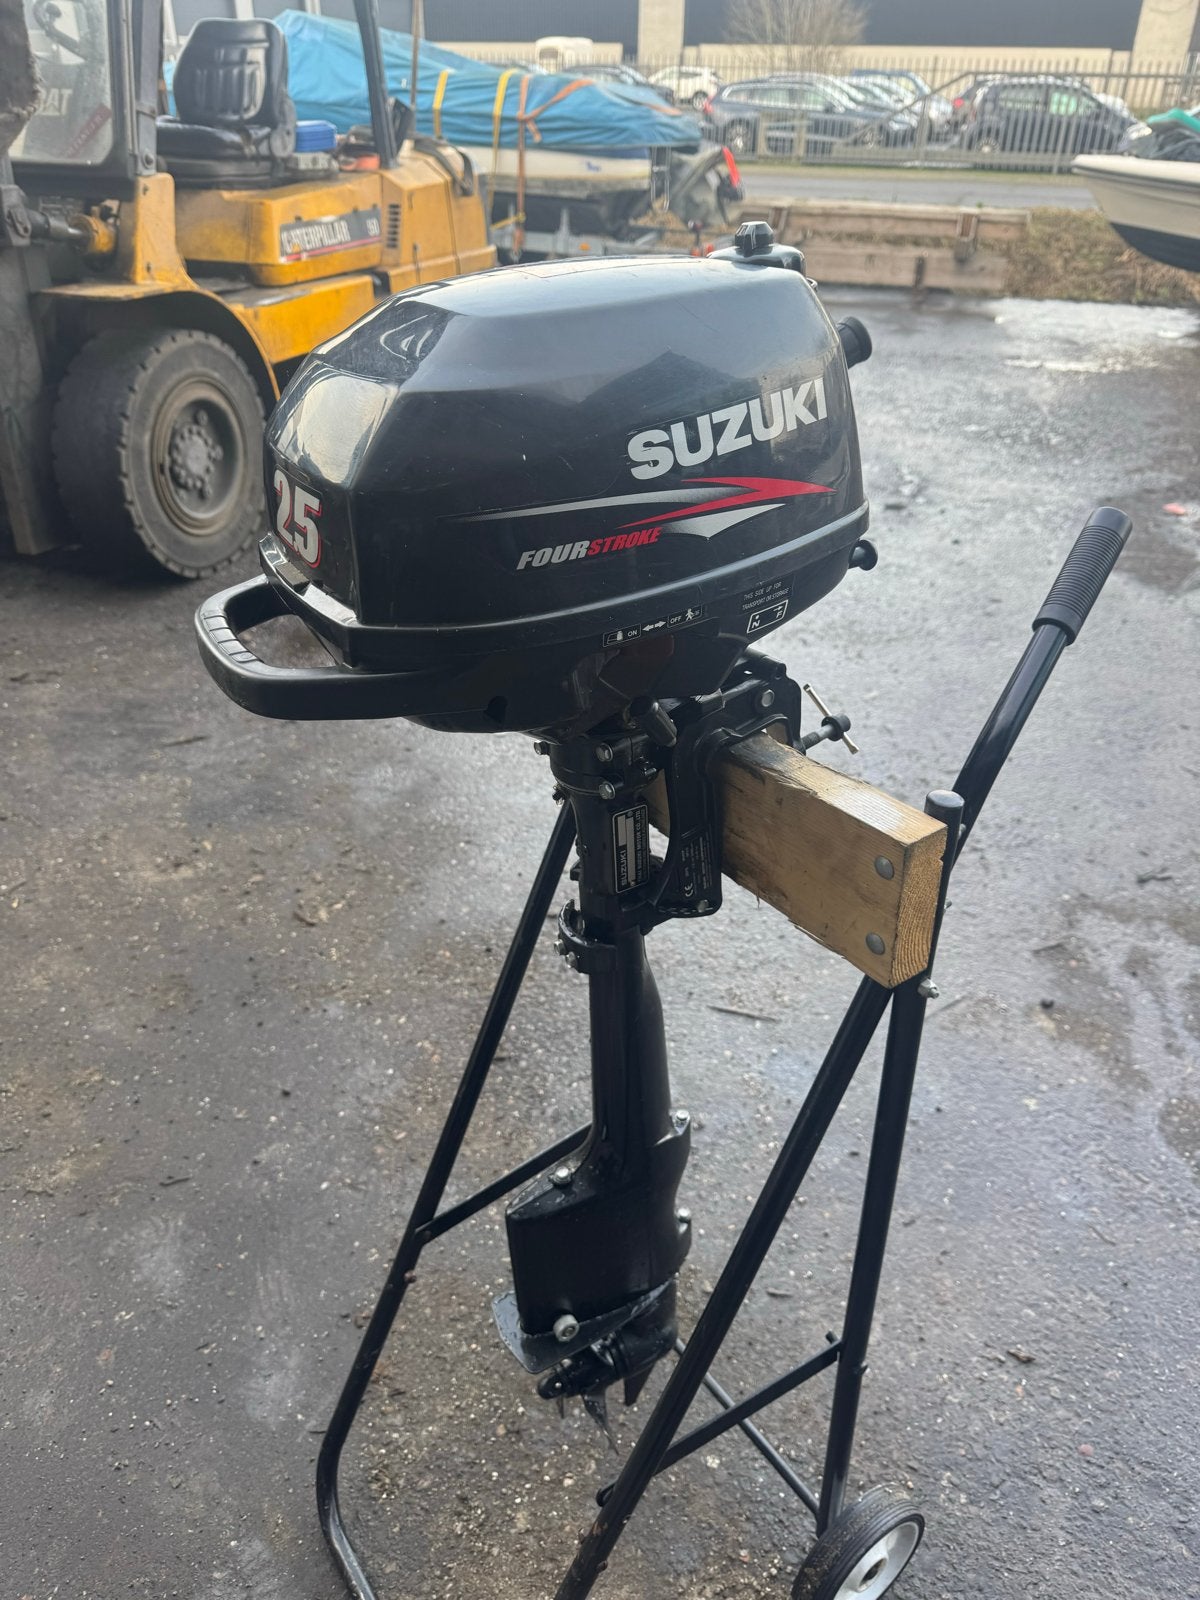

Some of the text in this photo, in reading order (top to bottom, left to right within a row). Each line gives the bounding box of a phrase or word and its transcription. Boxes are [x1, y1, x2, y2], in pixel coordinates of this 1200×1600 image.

[280, 219, 352, 254] CATERPILLAR
[627, 377, 828, 480] SUZUKI
[742, 597, 766, 610] TRANSPORT
[771, 587, 790, 600] STORAGE
[743, 581, 782, 601] THIS SIDE UP FOR
[669, 615, 682, 624] OFF
[751, 619, 760, 629] N
[775, 610, 784, 619] F
[627, 629, 638, 638] ON
[619, 849, 628, 886] SUZUKI
